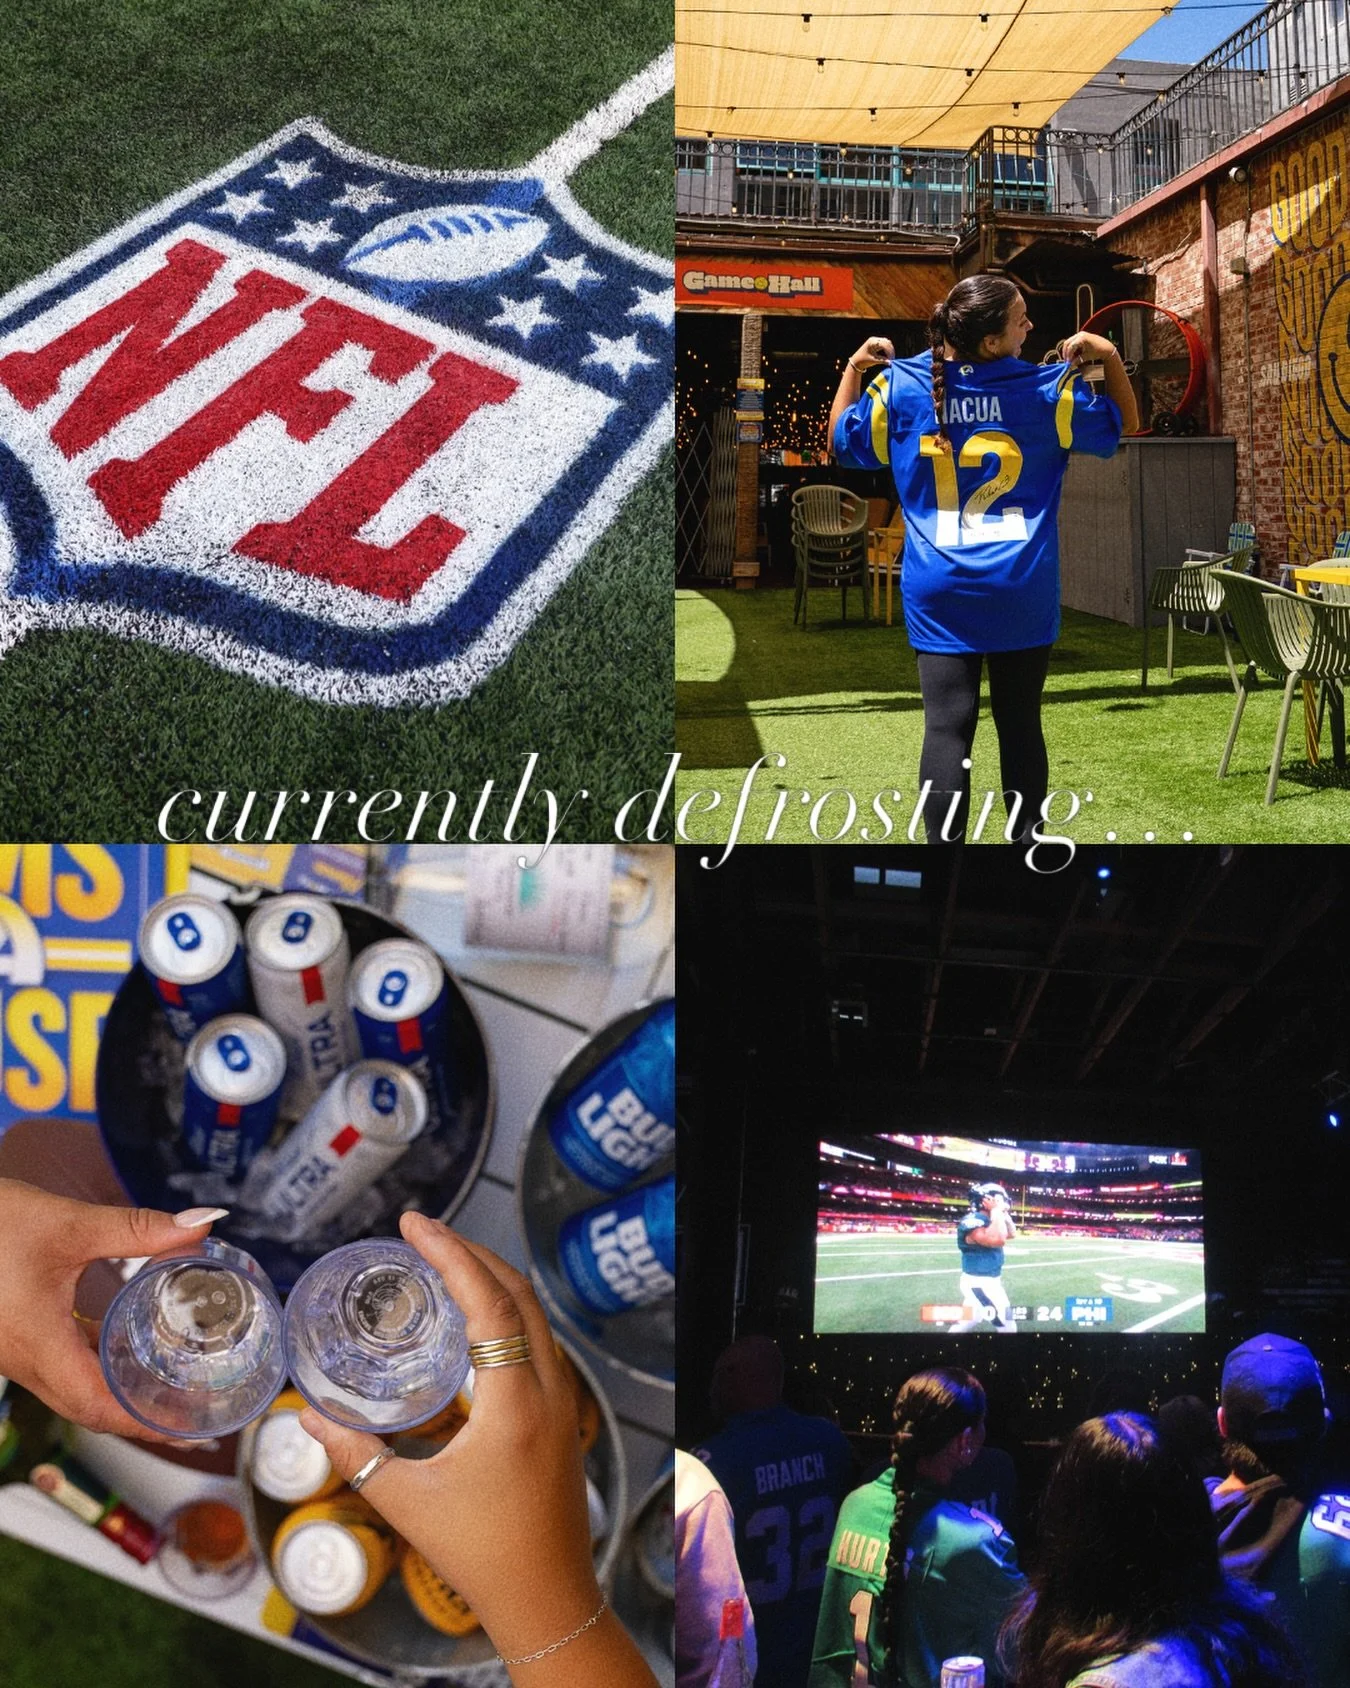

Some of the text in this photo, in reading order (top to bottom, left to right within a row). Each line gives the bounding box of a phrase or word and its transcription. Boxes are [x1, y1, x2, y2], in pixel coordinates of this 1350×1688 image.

[1270, 129, 1348, 248] GOOD
[683, 270, 823, 298] Game Hall
[0, 238, 521, 603] NFL
[920, 431, 1028, 547] 12
[1036, 1306, 1063, 1321] 24
[1071, 1306, 1107, 1321] PHI
[754, 1452, 826, 1496] BRANCH
[744, 1496, 835, 1605] 32
[836, 1530, 914, 1580] HUR
[850, 1590, 874, 1688] 1
